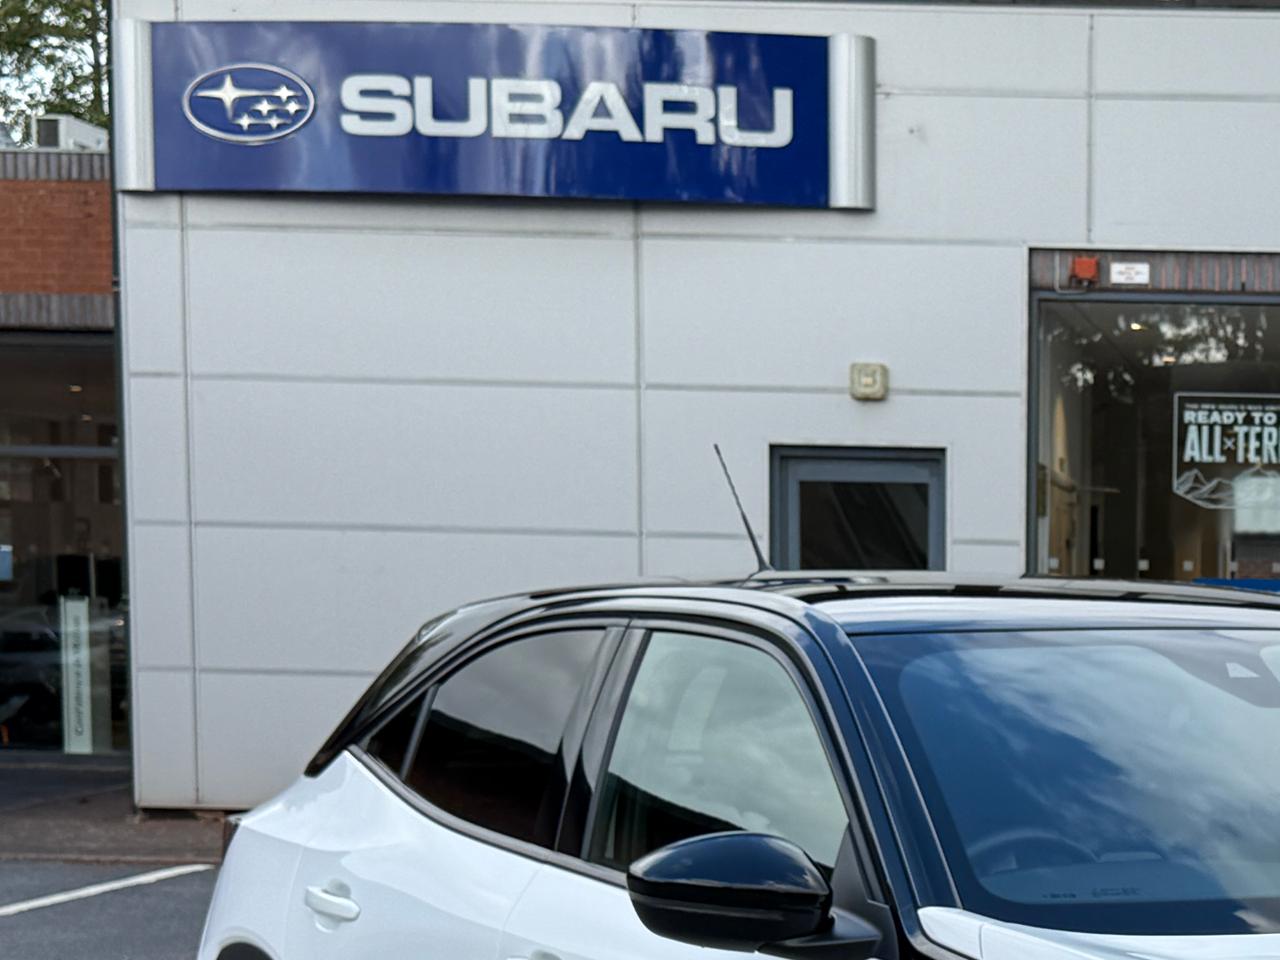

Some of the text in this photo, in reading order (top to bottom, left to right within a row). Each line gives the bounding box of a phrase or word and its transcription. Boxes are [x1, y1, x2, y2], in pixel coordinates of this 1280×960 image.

[340, 74, 793, 148] SUBARU
[1183, 409, 1248, 425] READY
[1251, 411, 1278, 425] TO
[1183, 424, 1227, 464] ALL
